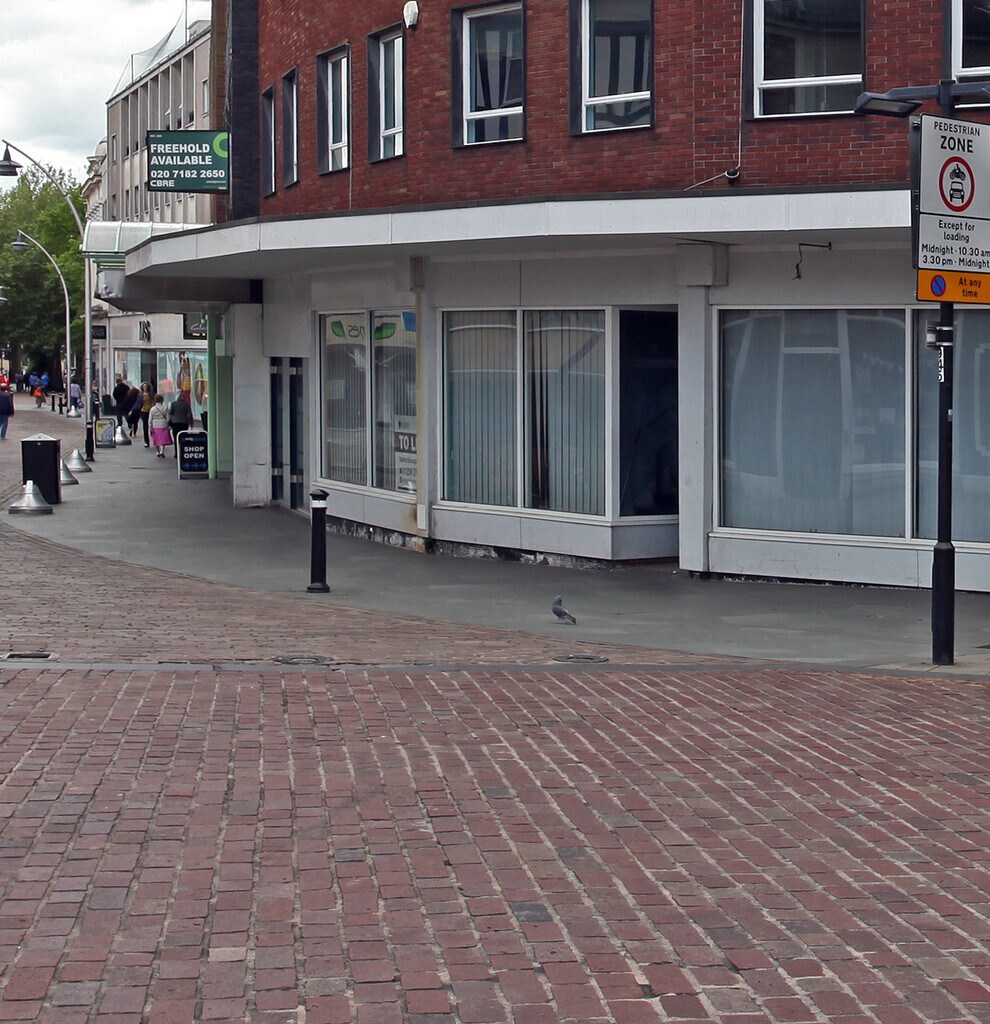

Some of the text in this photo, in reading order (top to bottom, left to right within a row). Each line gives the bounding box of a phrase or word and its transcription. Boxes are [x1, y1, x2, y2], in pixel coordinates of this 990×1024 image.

[934, 121, 980, 136] PEDESTRIAN
[150, 143, 210, 153] FREEHOLD
[940, 135, 973, 153] ZONE
[150, 156, 212, 165] AVAILABLE
[150, 170, 225, 178] 020 7182 2650
[150, 179, 175, 187] CBRE
[938, 220, 975, 231] Except for
[943, 232, 970, 243] loading
[921, 243, 954, 255] Midnight
[959, 246, 980, 256] 10.30
[922, 255, 941, 264] 3.30
[942, 258, 953, 266] pm
[958, 258, 990, 269] Midnight
[958, 277, 982, 288] At any
[962, 288, 978, 298] time
[399, 435, 410, 450] TO
